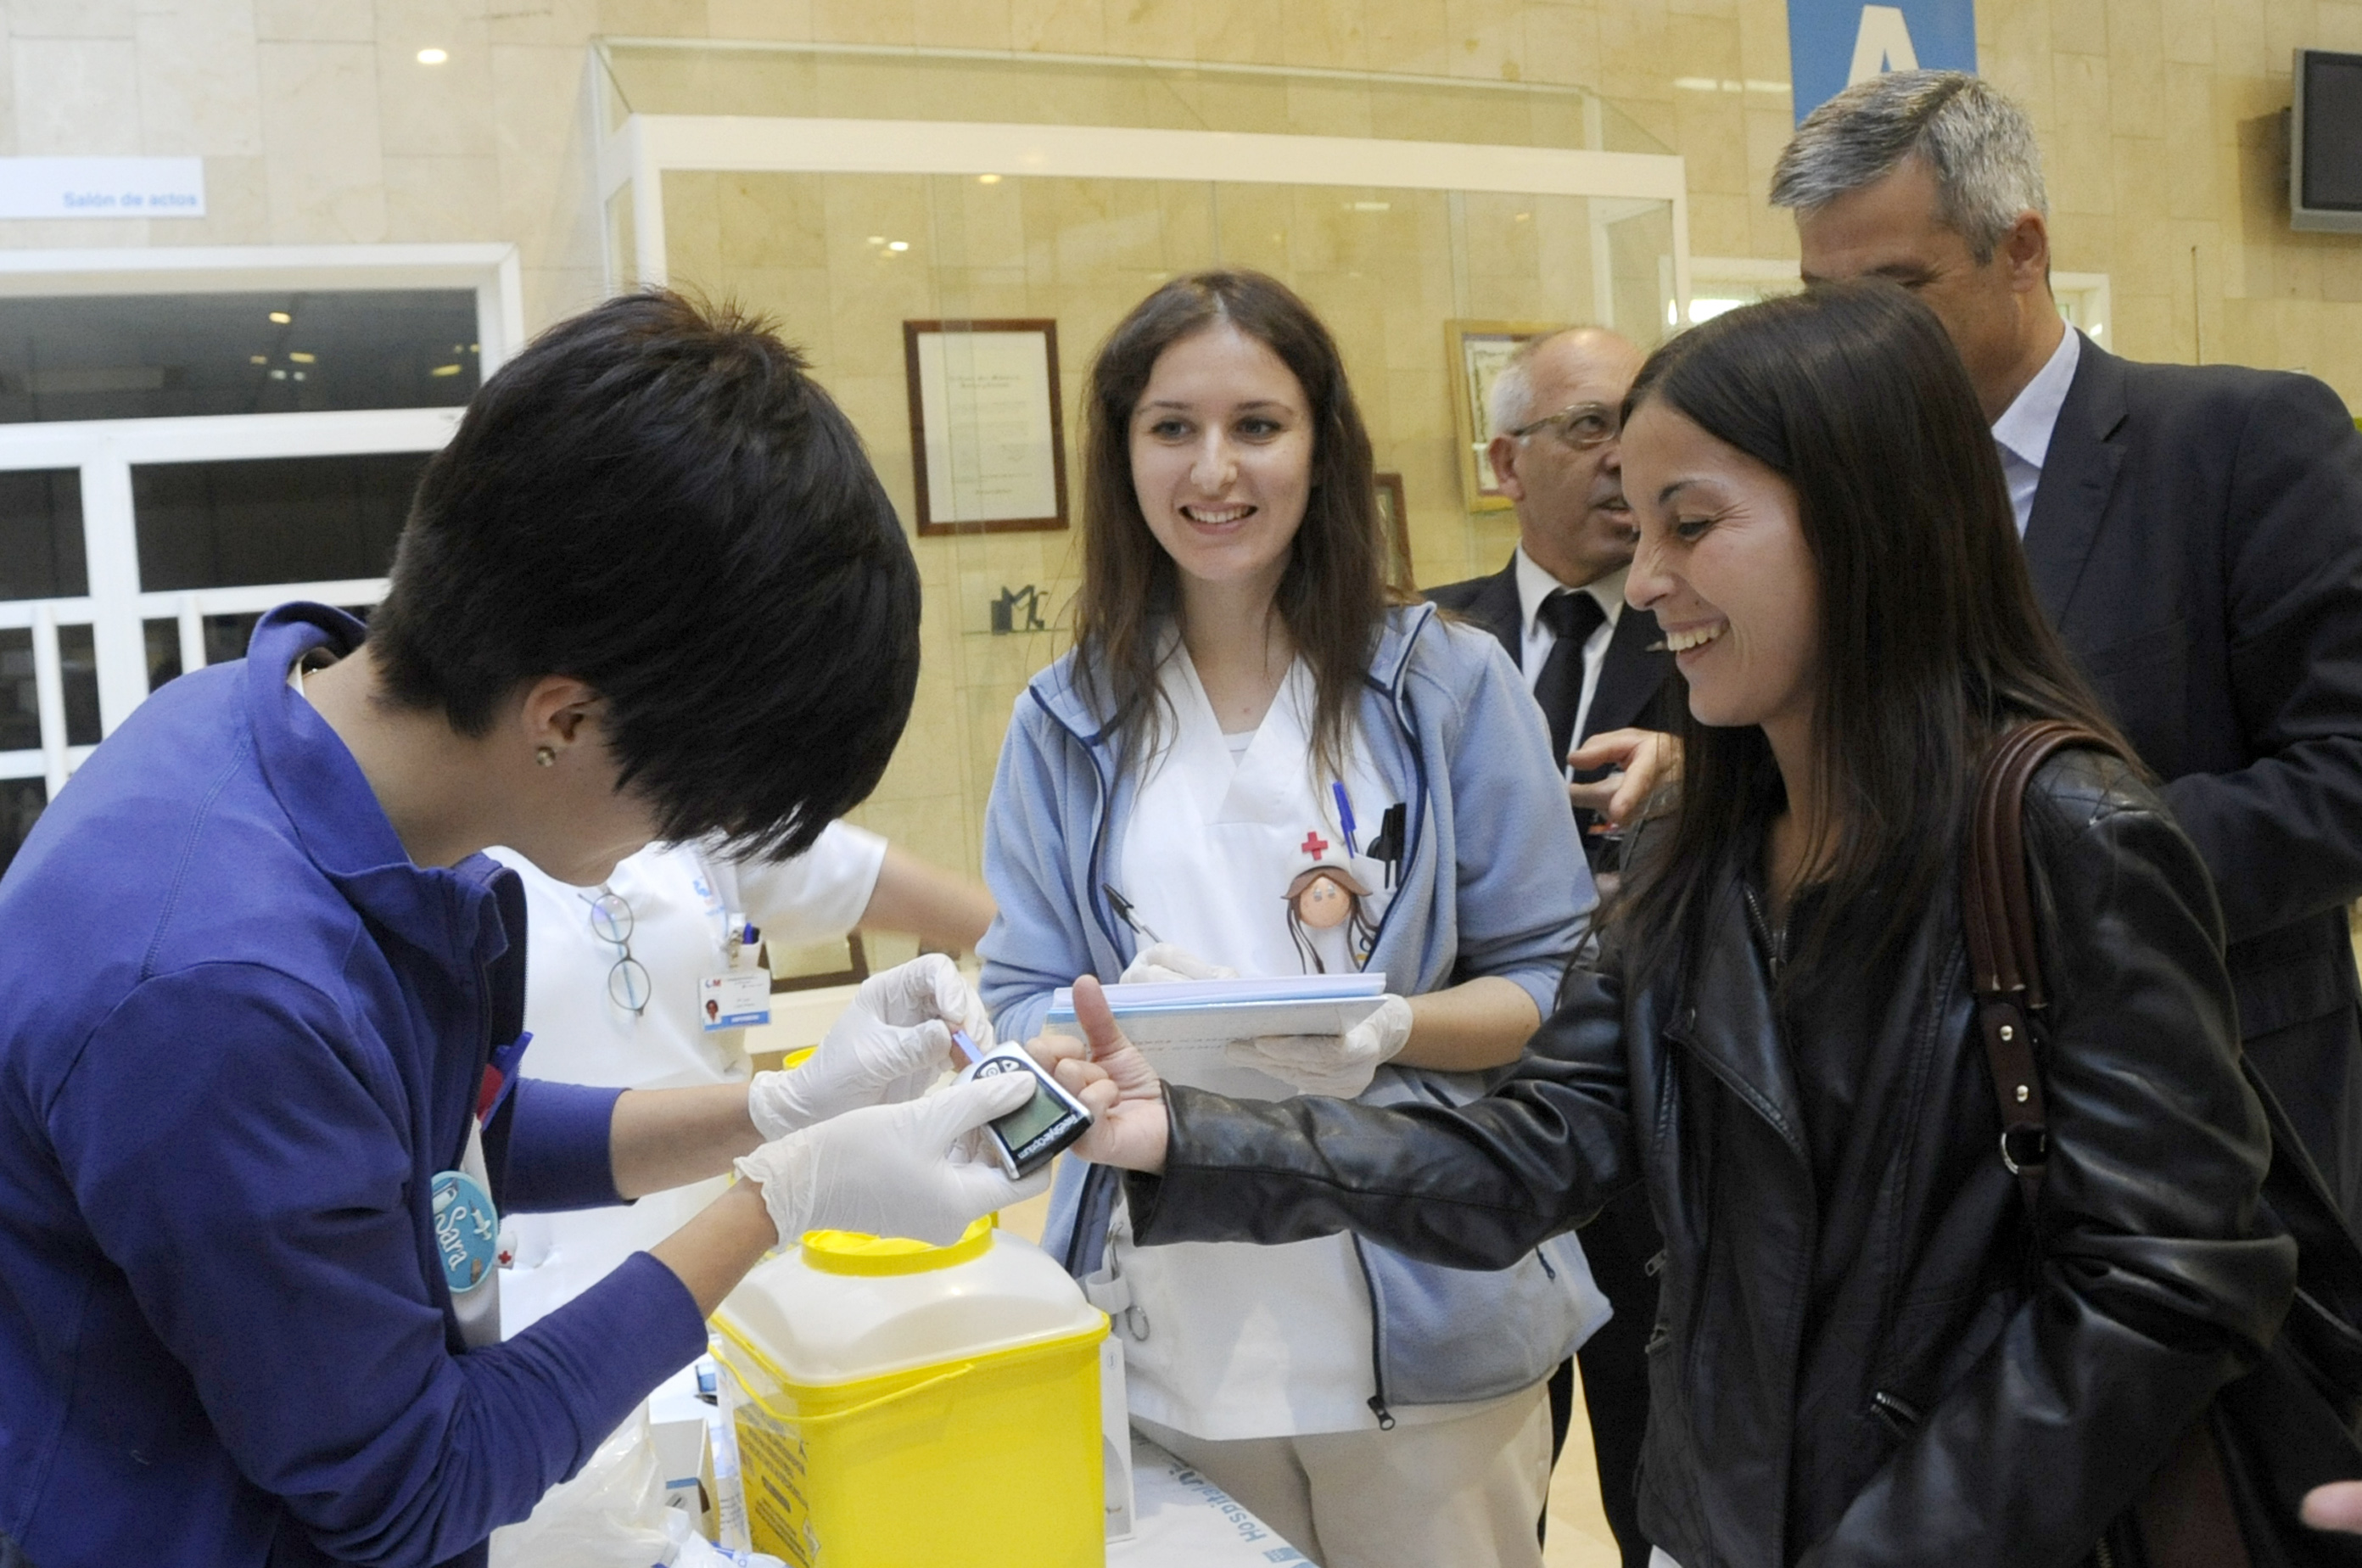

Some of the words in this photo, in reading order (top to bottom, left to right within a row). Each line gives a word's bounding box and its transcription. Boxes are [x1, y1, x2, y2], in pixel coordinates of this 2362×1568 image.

[120, 193, 143, 206] de
[149, 193, 197, 206] actos
[434, 1206, 467, 1272] Sara
[1190, 1486, 1268, 1543] Hospital
